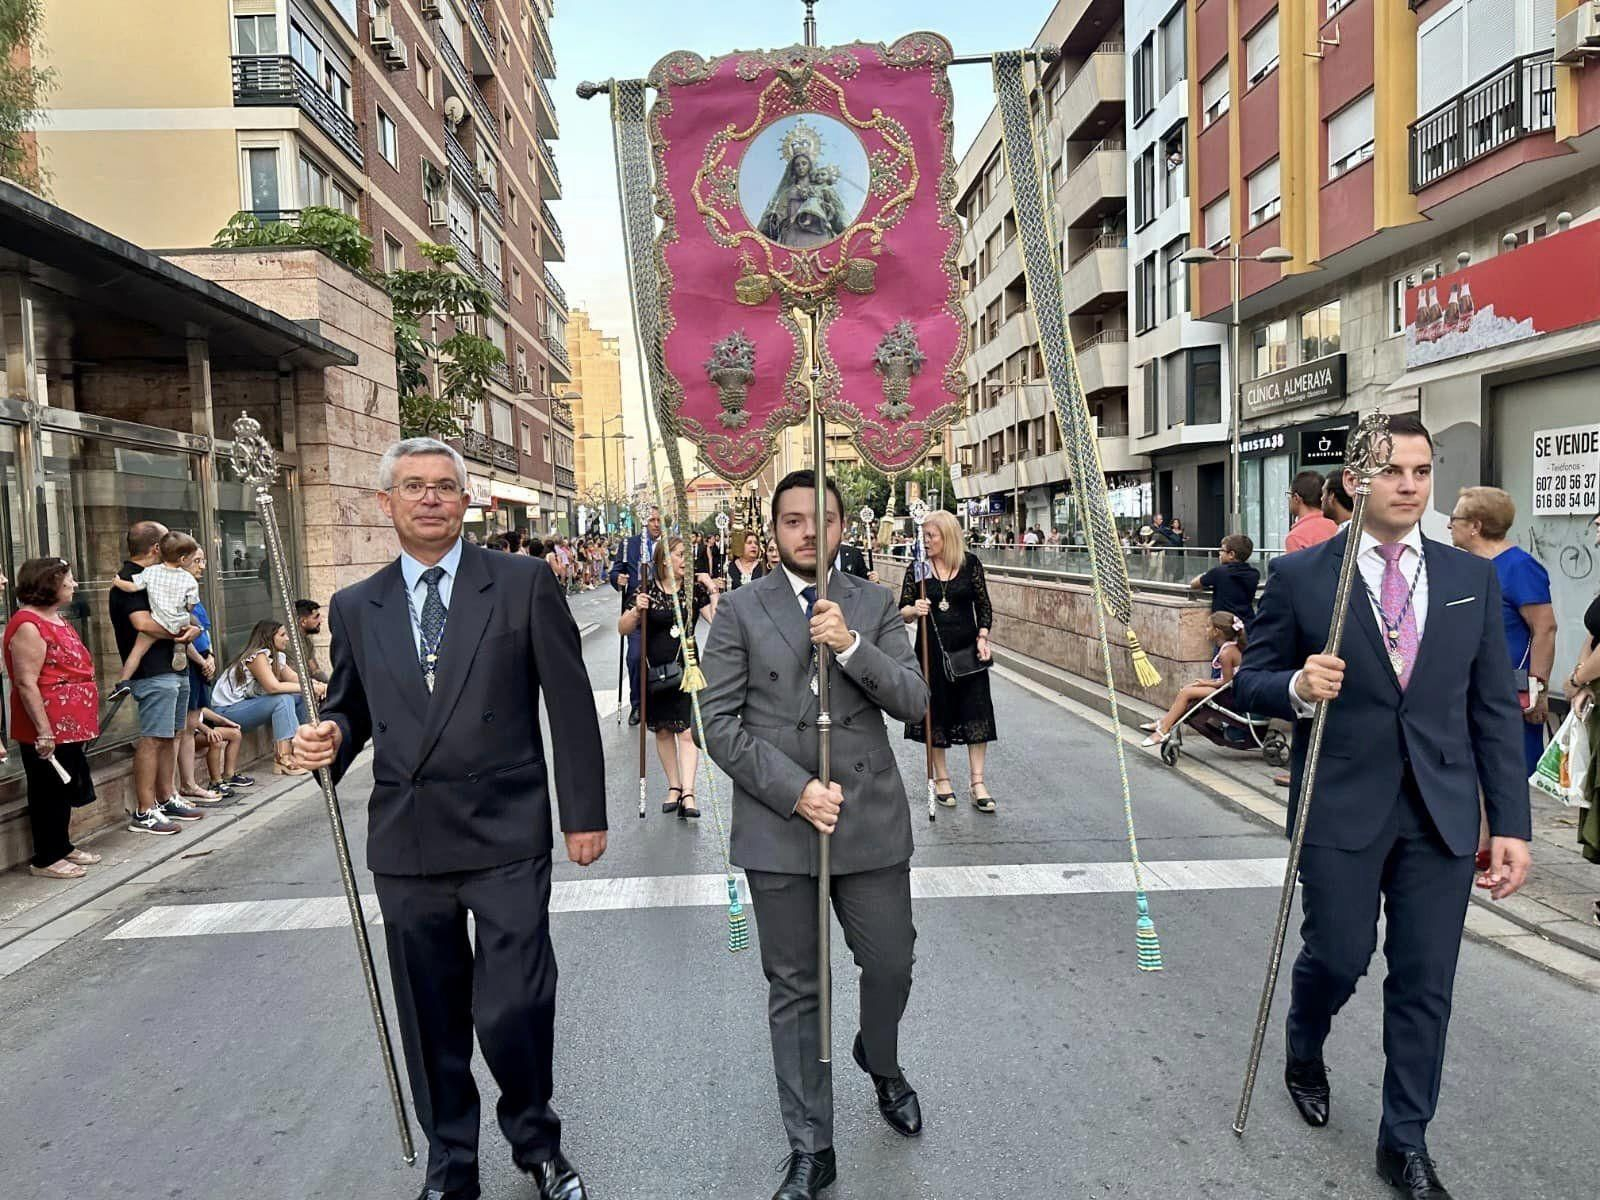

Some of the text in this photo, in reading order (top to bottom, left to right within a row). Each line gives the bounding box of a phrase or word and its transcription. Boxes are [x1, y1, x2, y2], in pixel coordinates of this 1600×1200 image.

[1247, 383, 1280, 406] CLÍNICA
[1283, 368, 1332, 397] ALMERAYA
[1535, 431, 1599, 457] SE VENDE
[1536, 473, 1596, 491] 607 20 56 37
[1536, 492, 1595, 508] 616 68 54 04
